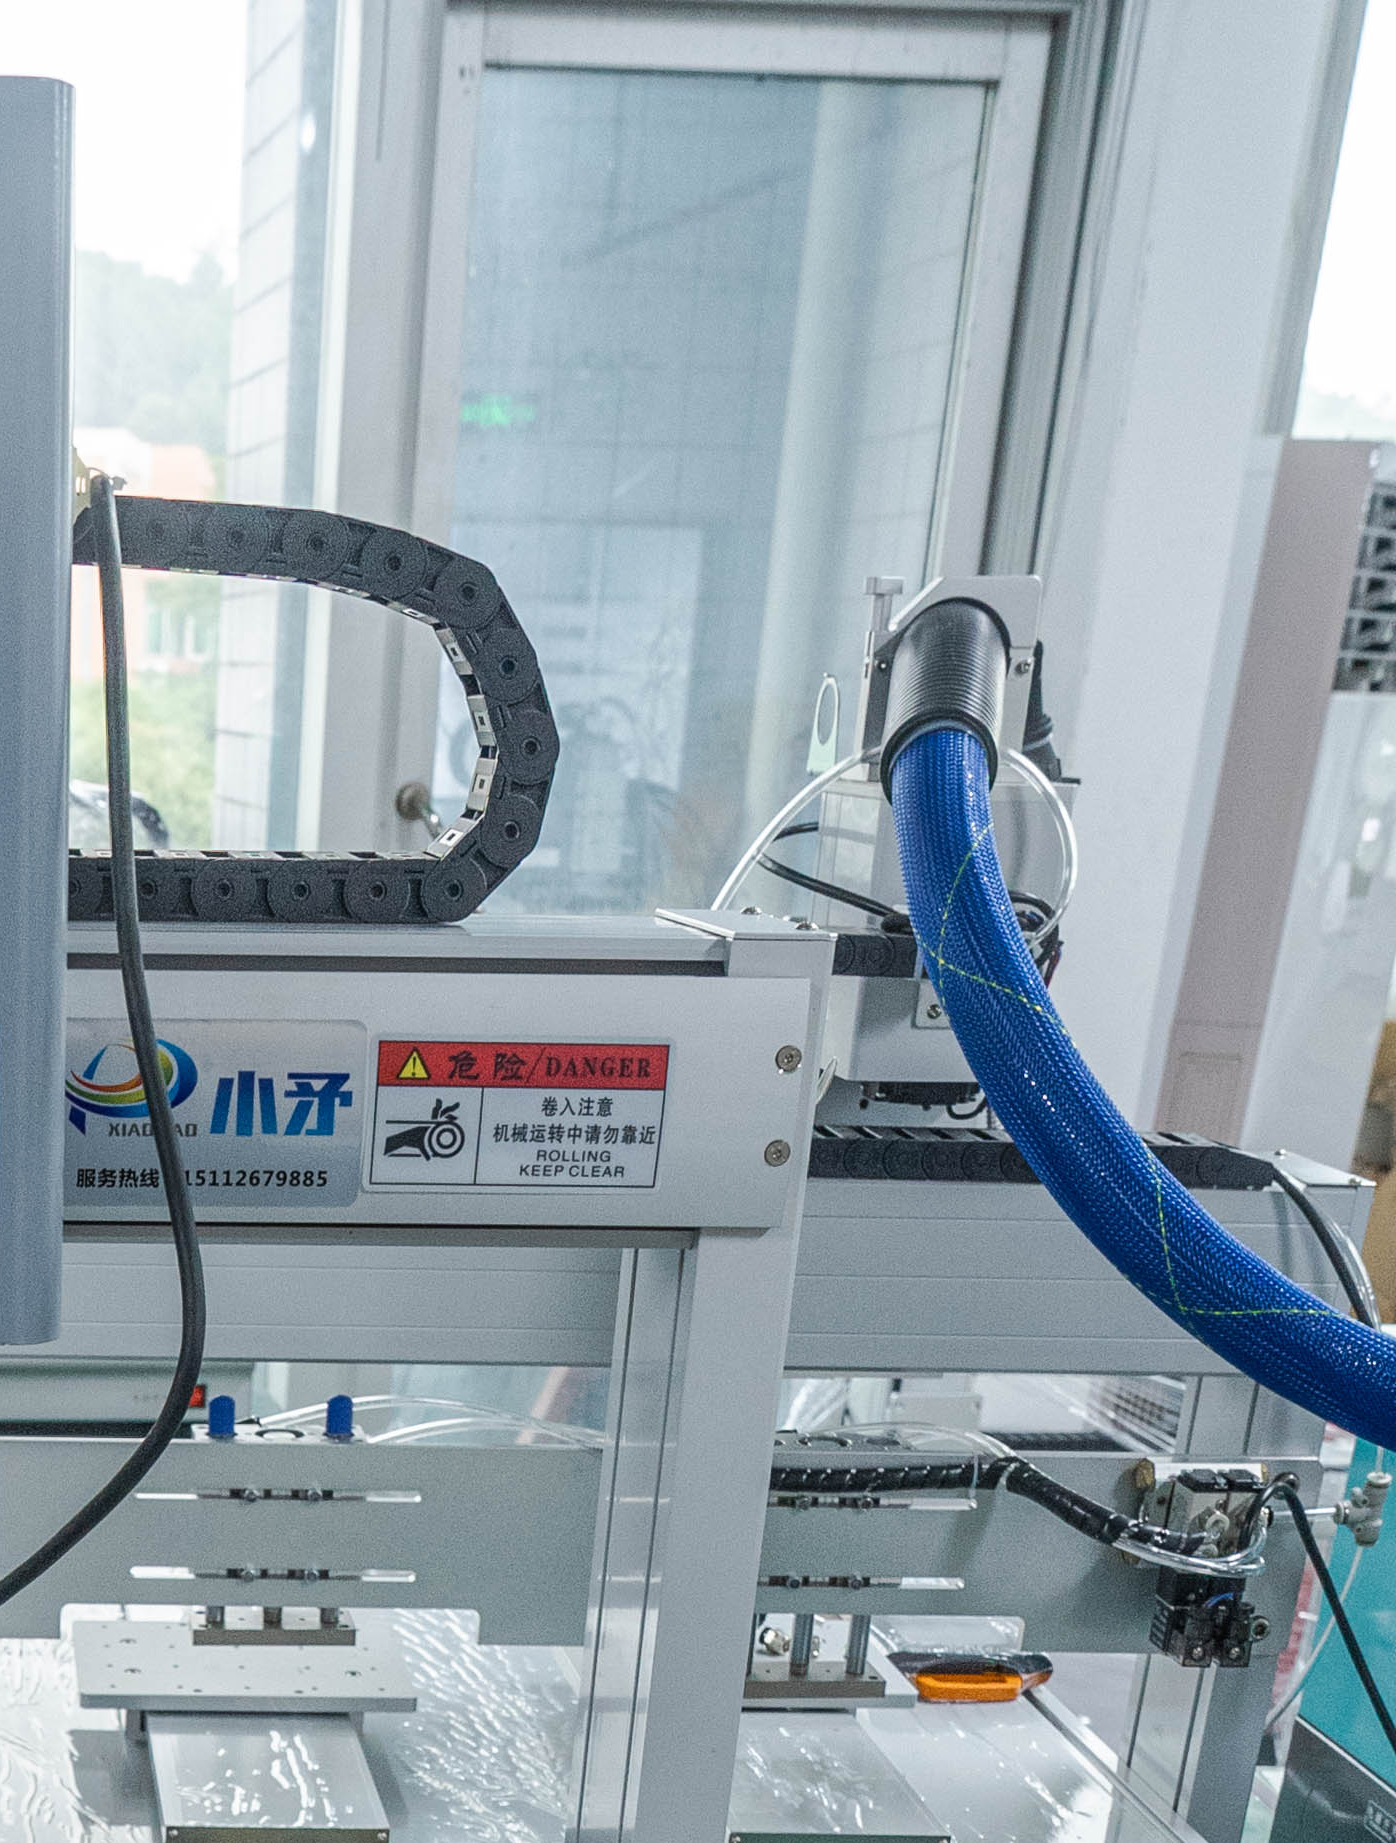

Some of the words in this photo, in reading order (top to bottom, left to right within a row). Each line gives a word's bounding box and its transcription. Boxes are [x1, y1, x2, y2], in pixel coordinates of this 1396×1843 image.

[210, 1070, 353, 1136] 小矛
[541, 1096, 614, 1117] 卷入注意
[108, 1122, 198, 1137] XIAOAO
[492, 1123, 657, 1146] 机械运转中请勿靠近
[536, 1150, 611, 1163] ROLLING
[76, 1168, 159, 1188] 服务热线
[519, 1164, 564, 1177] KEEP
[569, 1165, 625, 1178] CLEAR
